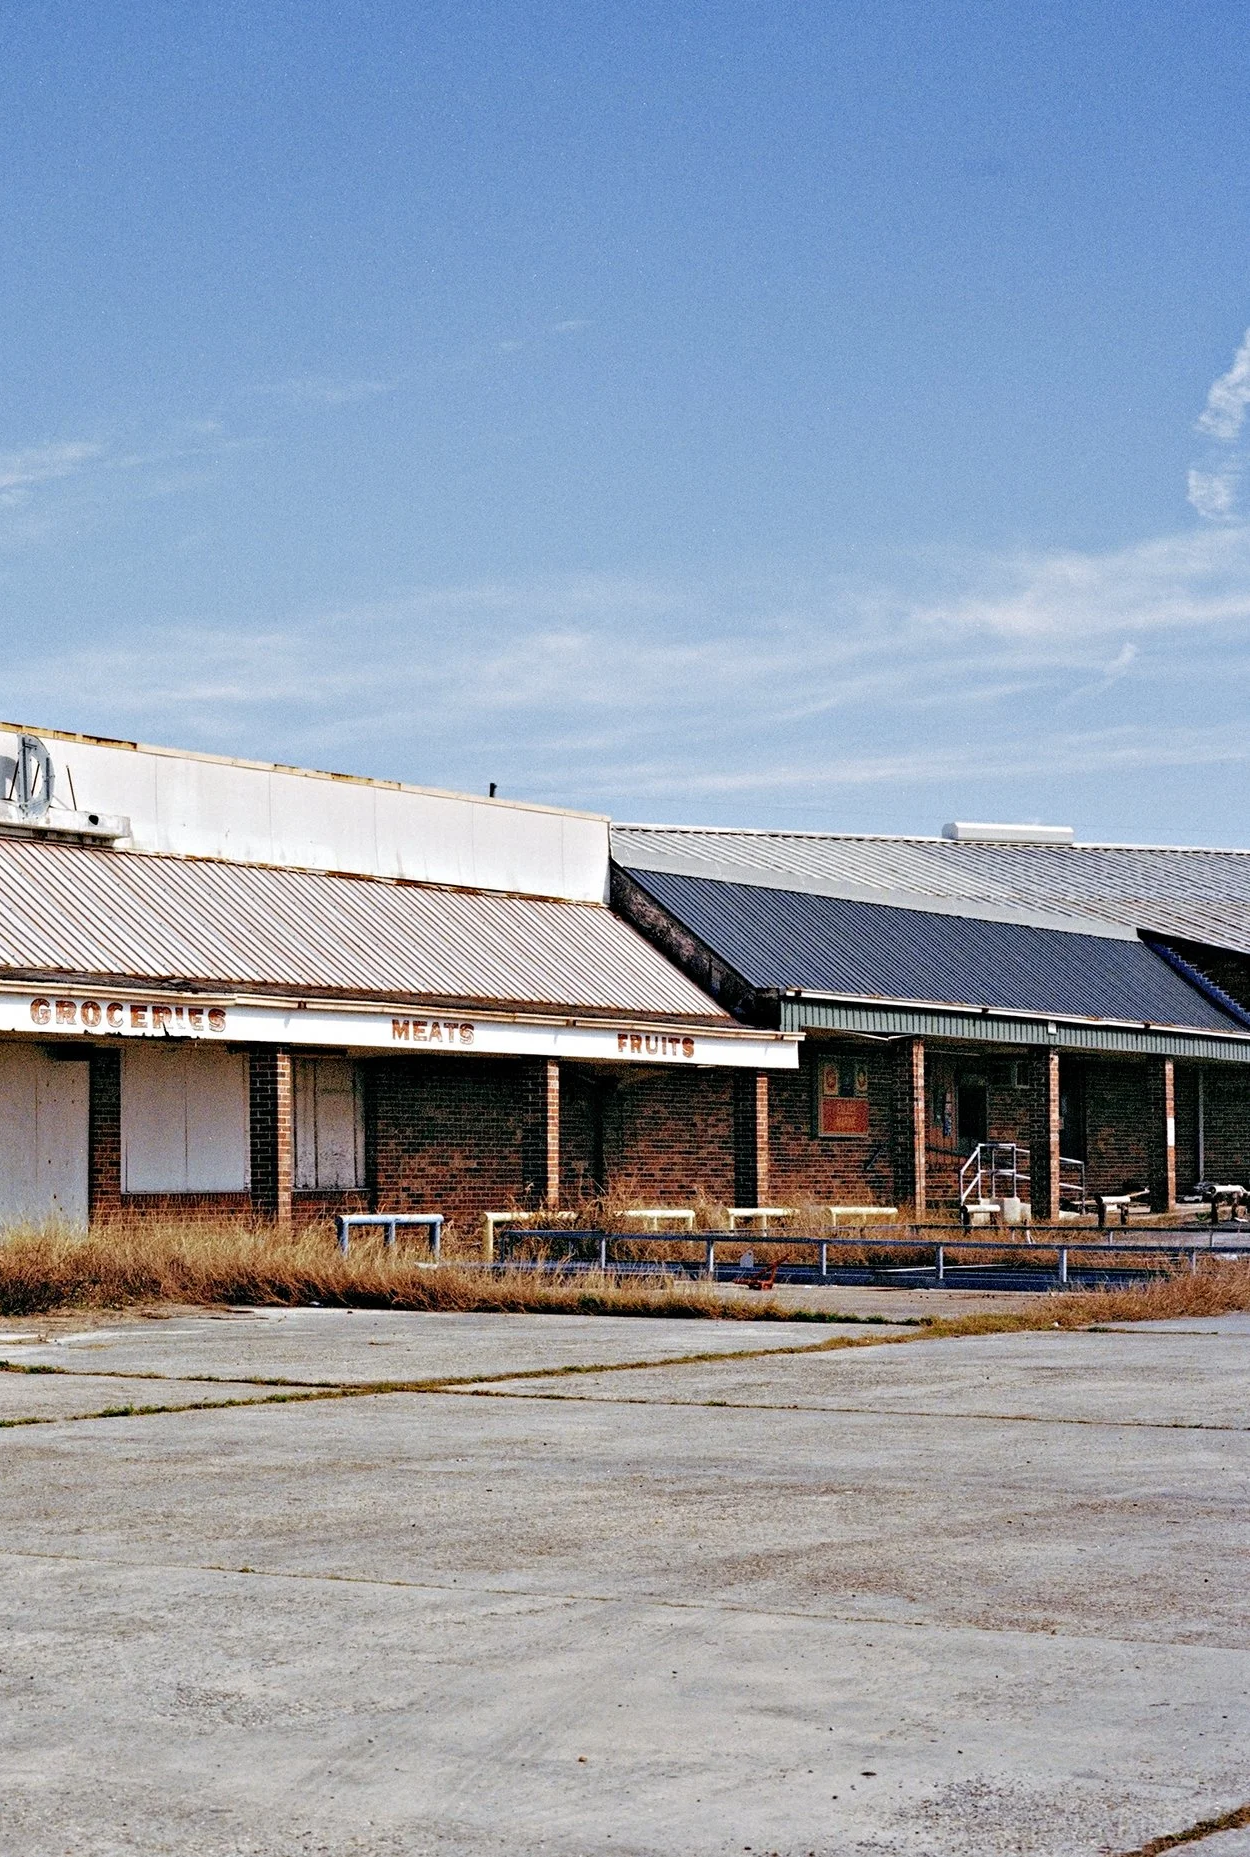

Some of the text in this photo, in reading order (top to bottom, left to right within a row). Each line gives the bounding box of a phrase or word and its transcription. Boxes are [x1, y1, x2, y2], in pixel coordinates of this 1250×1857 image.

[29, 998, 227, 1033] GROCERIES
[391, 1019, 475, 1045] MEATS
[617, 1034, 695, 1058] FRUITS
